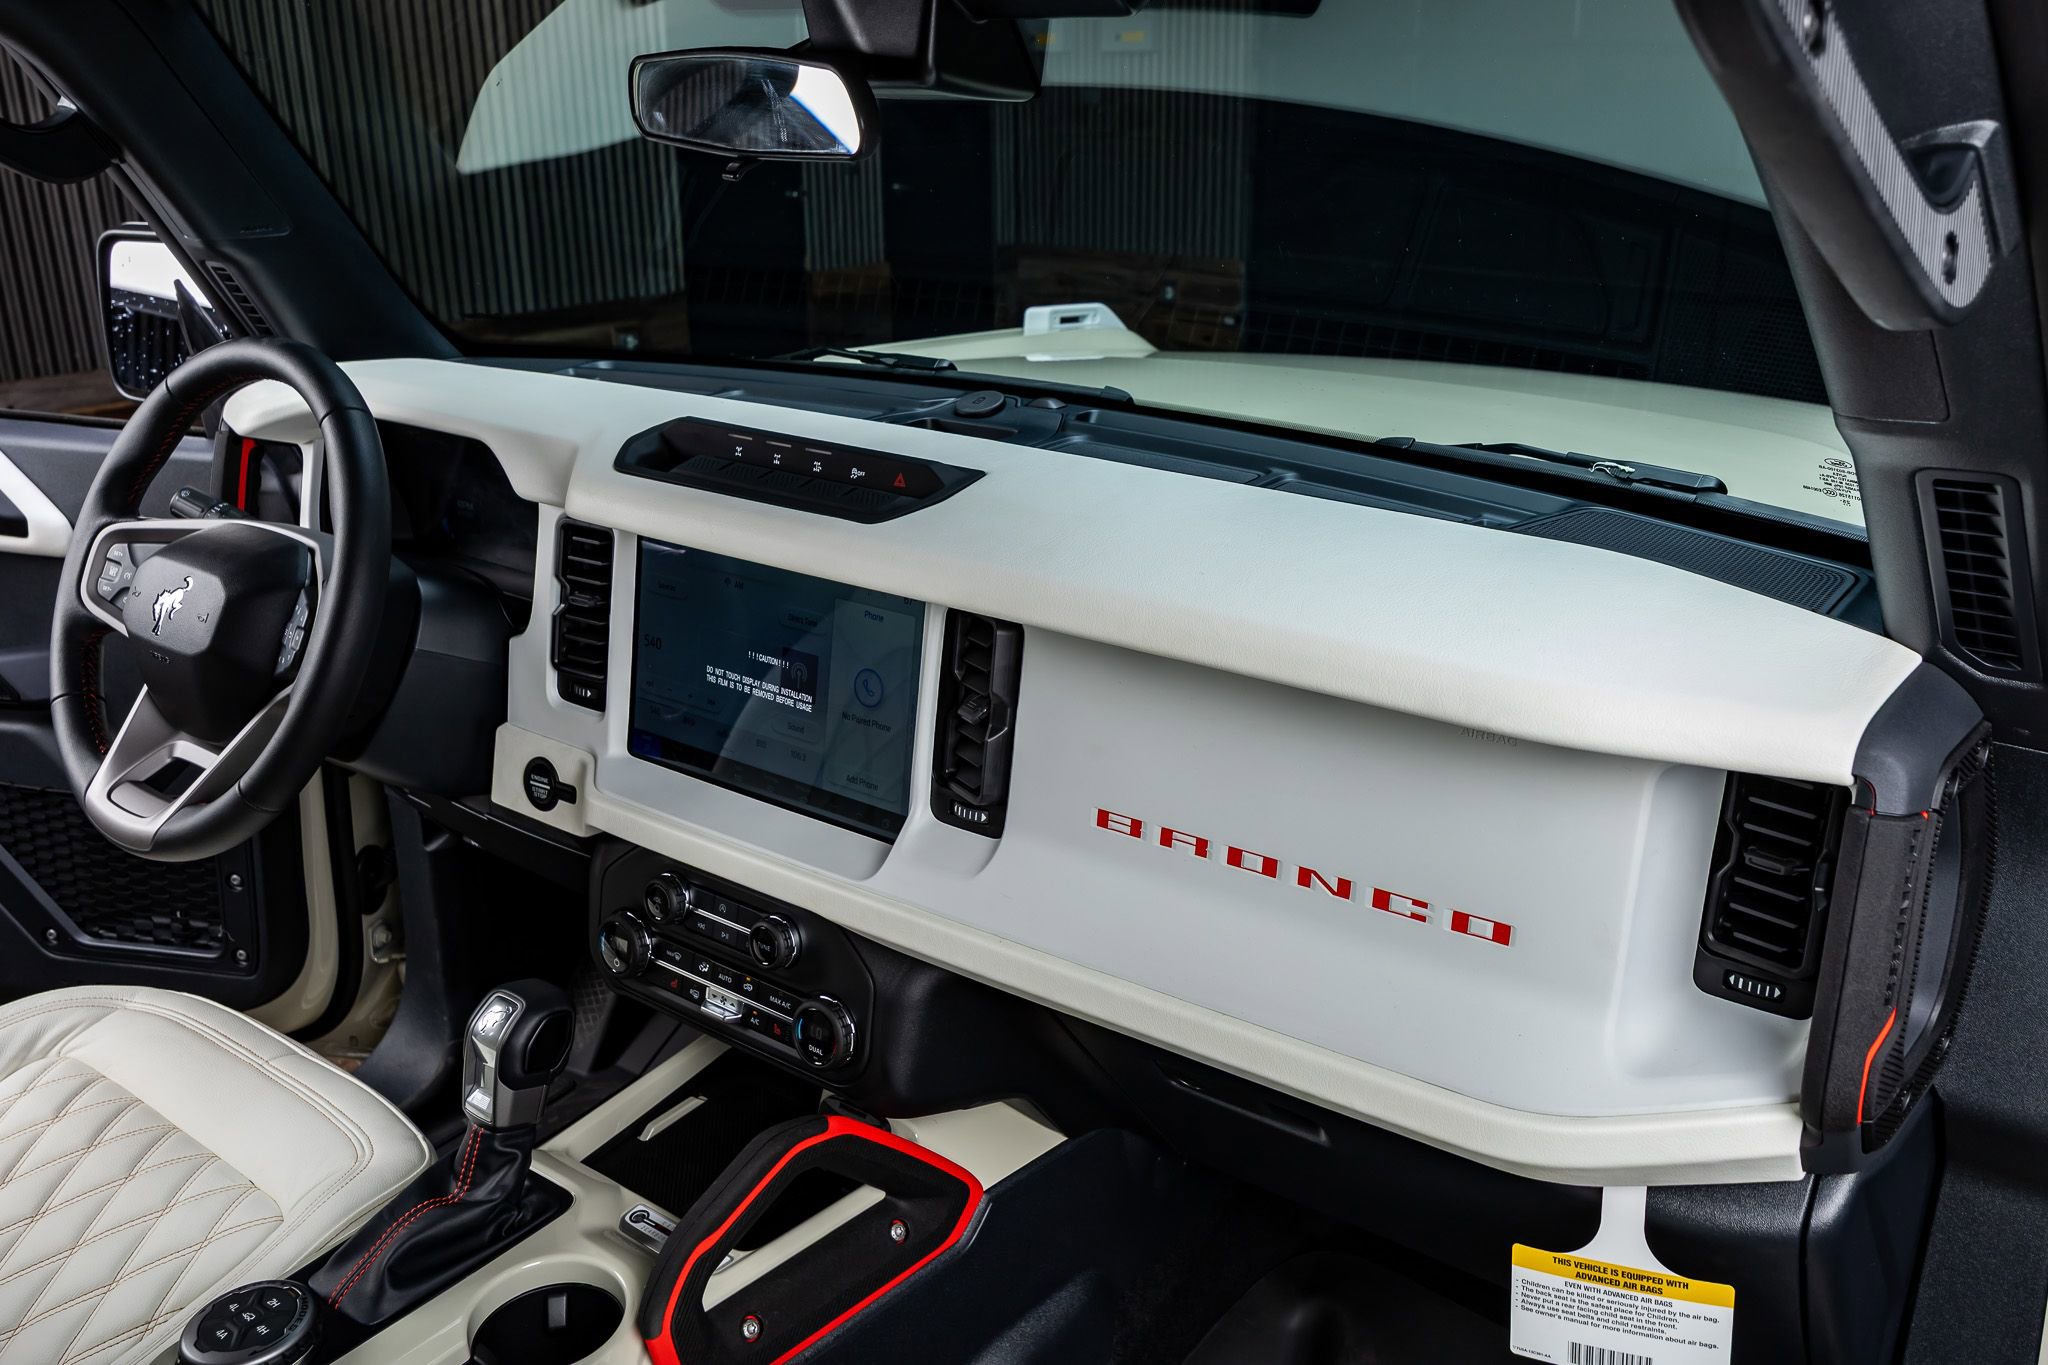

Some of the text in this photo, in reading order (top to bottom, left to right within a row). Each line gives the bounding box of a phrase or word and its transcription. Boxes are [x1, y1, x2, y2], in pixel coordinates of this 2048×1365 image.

[863, 610, 884, 623] Phone
[644, 633, 662, 650] 540
[706, 665, 812, 703] DO NOT TOUCH DISPLAY DURING INSTALLATION
[706, 674, 812, 713] THIS FILM IS TO BE REMOVED BEFORE USAGE
[872, 719, 892, 733] Phone
[1093, 807, 1514, 947] BRONCO
[718, 973, 732, 984] AUTO
[769, 994, 792, 1010] MAX A/C
[750, 1016, 760, 1026] A/C
[808, 1044, 823, 1056] DUAL
[1552, 1256, 1571, 1267] THIS
[1574, 1260, 1608, 1274] VEHICLE
[1622, 1271, 1663, 1284] EQUIPPED
[1666, 1279, 1688, 1289] WITH
[1575, 1271, 1663, 1294] ADVANCED AIR BAGS
[267, 1298, 280, 1308] 2H
[1521, 1279, 1550, 1290] Children
[1566, 1288, 1574, 1296] be
[1576, 1292, 1595, 1300] killed
[1606, 1298, 1639, 1309] seriously
[1641, 1305, 1666, 1314] injured
[1668, 1310, 1677, 1318] by
[1704, 1316, 1719, 1324] bag.
[1521, 1285, 1534, 1293] The
[1536, 1288, 1552, 1297] back
[1554, 1293, 1568, 1301] seat
[1591, 1300, 1612, 1311] safest
[1614, 1307, 1633, 1316] place
[1647, 1313, 1679, 1324] Children.
[1565, 1281, 1581, 1290] EVEN
[1584, 1285, 1601, 1294] WITH
[1603, 1289, 1638, 1301] ADVANCED
[1655, 1299, 1672, 1307] BAGS
[1521, 1292, 1540, 1302] Never
[1542, 1297, 1554, 1305] put
[1577, 1305, 1598, 1315] facing
[1600, 1310, 1617, 1319] child
[1620, 1314, 1634, 1322] seat
[1645, 1317, 1656, 1326] the
[1658, 1321, 1677, 1330] front.
[1521, 1298, 1545, 1309] Always
[1561, 1308, 1576, 1316] seat
[1577, 1312, 1594, 1320] belts
[1596, 1315, 1610, 1323] and
[1611, 1318, 1628, 1327] child
[1631, 1323, 1666, 1335] restraints.
[1521, 1304, 1533, 1312] See
[1535, 1309, 1561, 1320] owner's
[1563, 1315, 1589, 1326] manual
[1602, 1324, 1620, 1332] more
[1622, 1327, 1663, 1341] information
[1665, 1336, 1686, 1345] about
[1699, 1341, 1719, 1350] bags.
